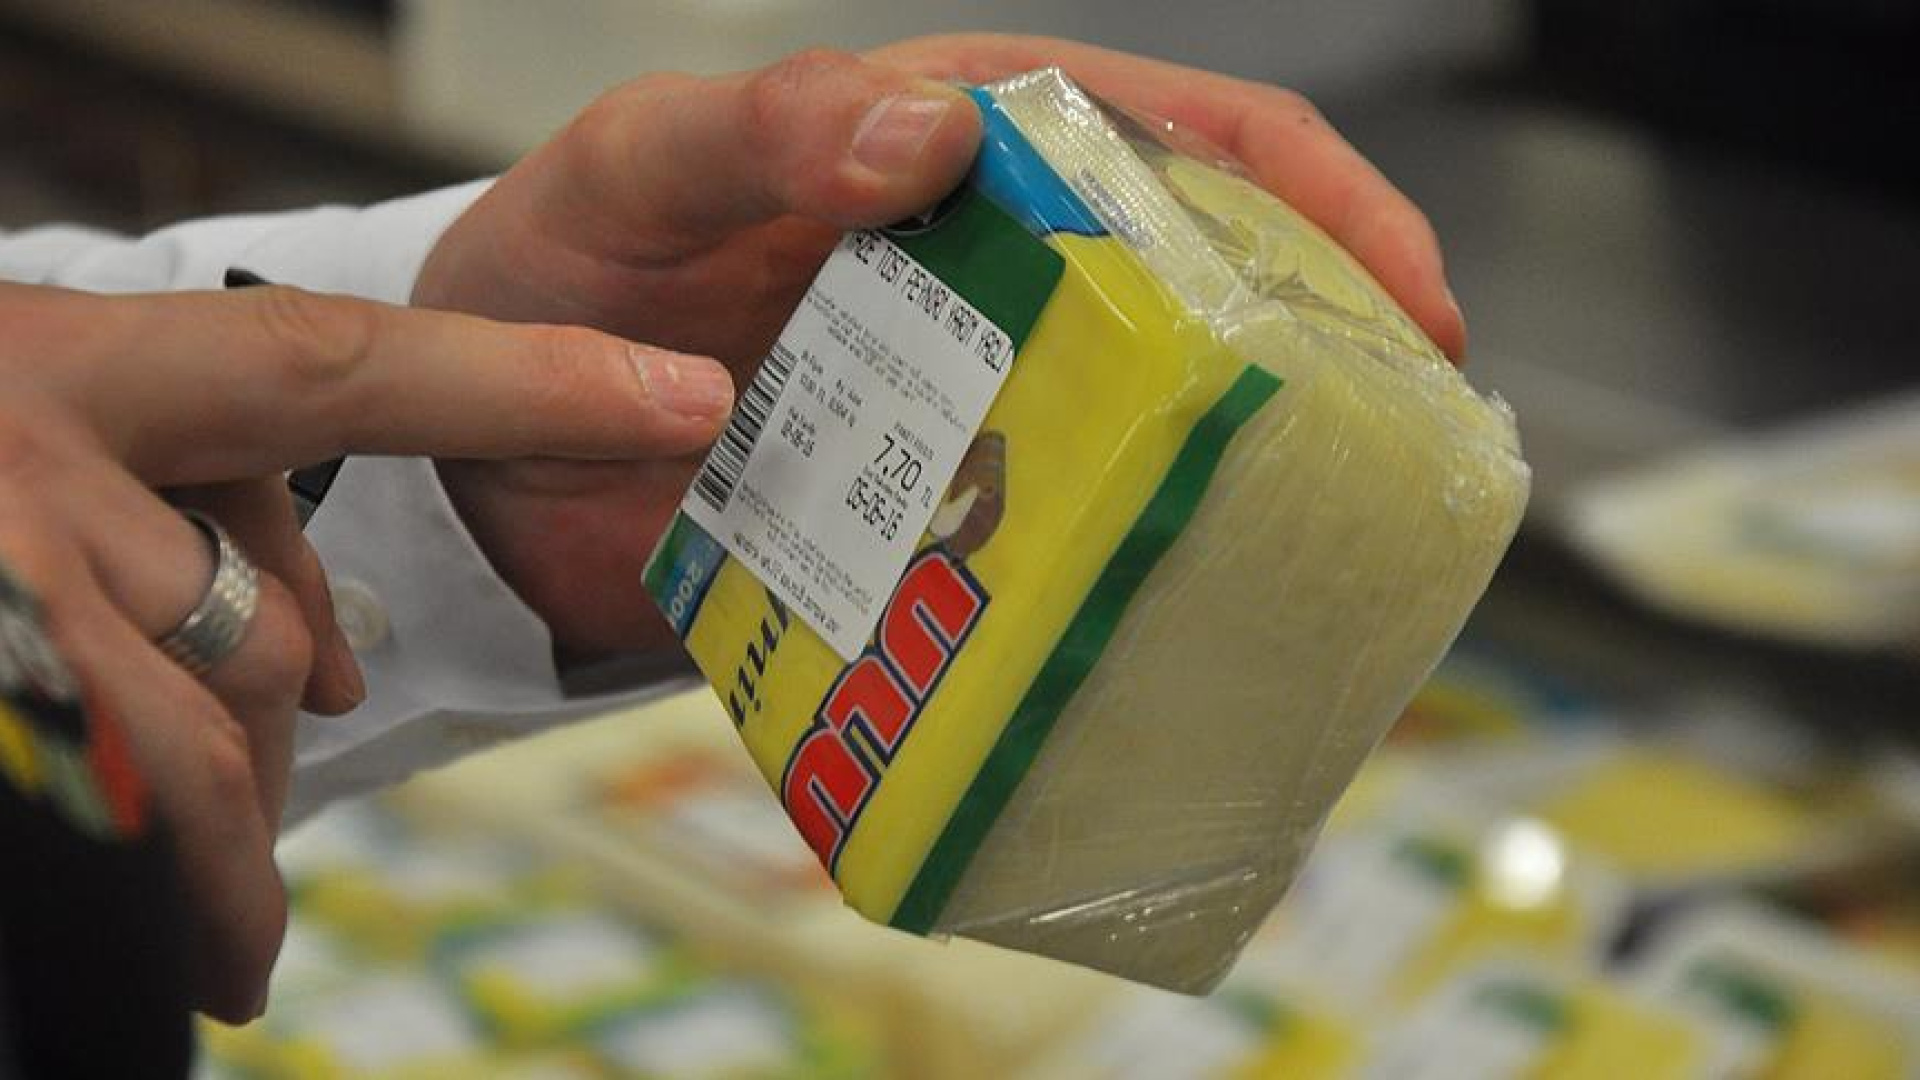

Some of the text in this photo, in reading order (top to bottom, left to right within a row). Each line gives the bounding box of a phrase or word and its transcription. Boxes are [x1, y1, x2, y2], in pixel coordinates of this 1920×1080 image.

[877, 245, 909, 286] TOST
[874, 432, 921, 491] 7.70
[846, 477, 903, 540] 05-06-16
